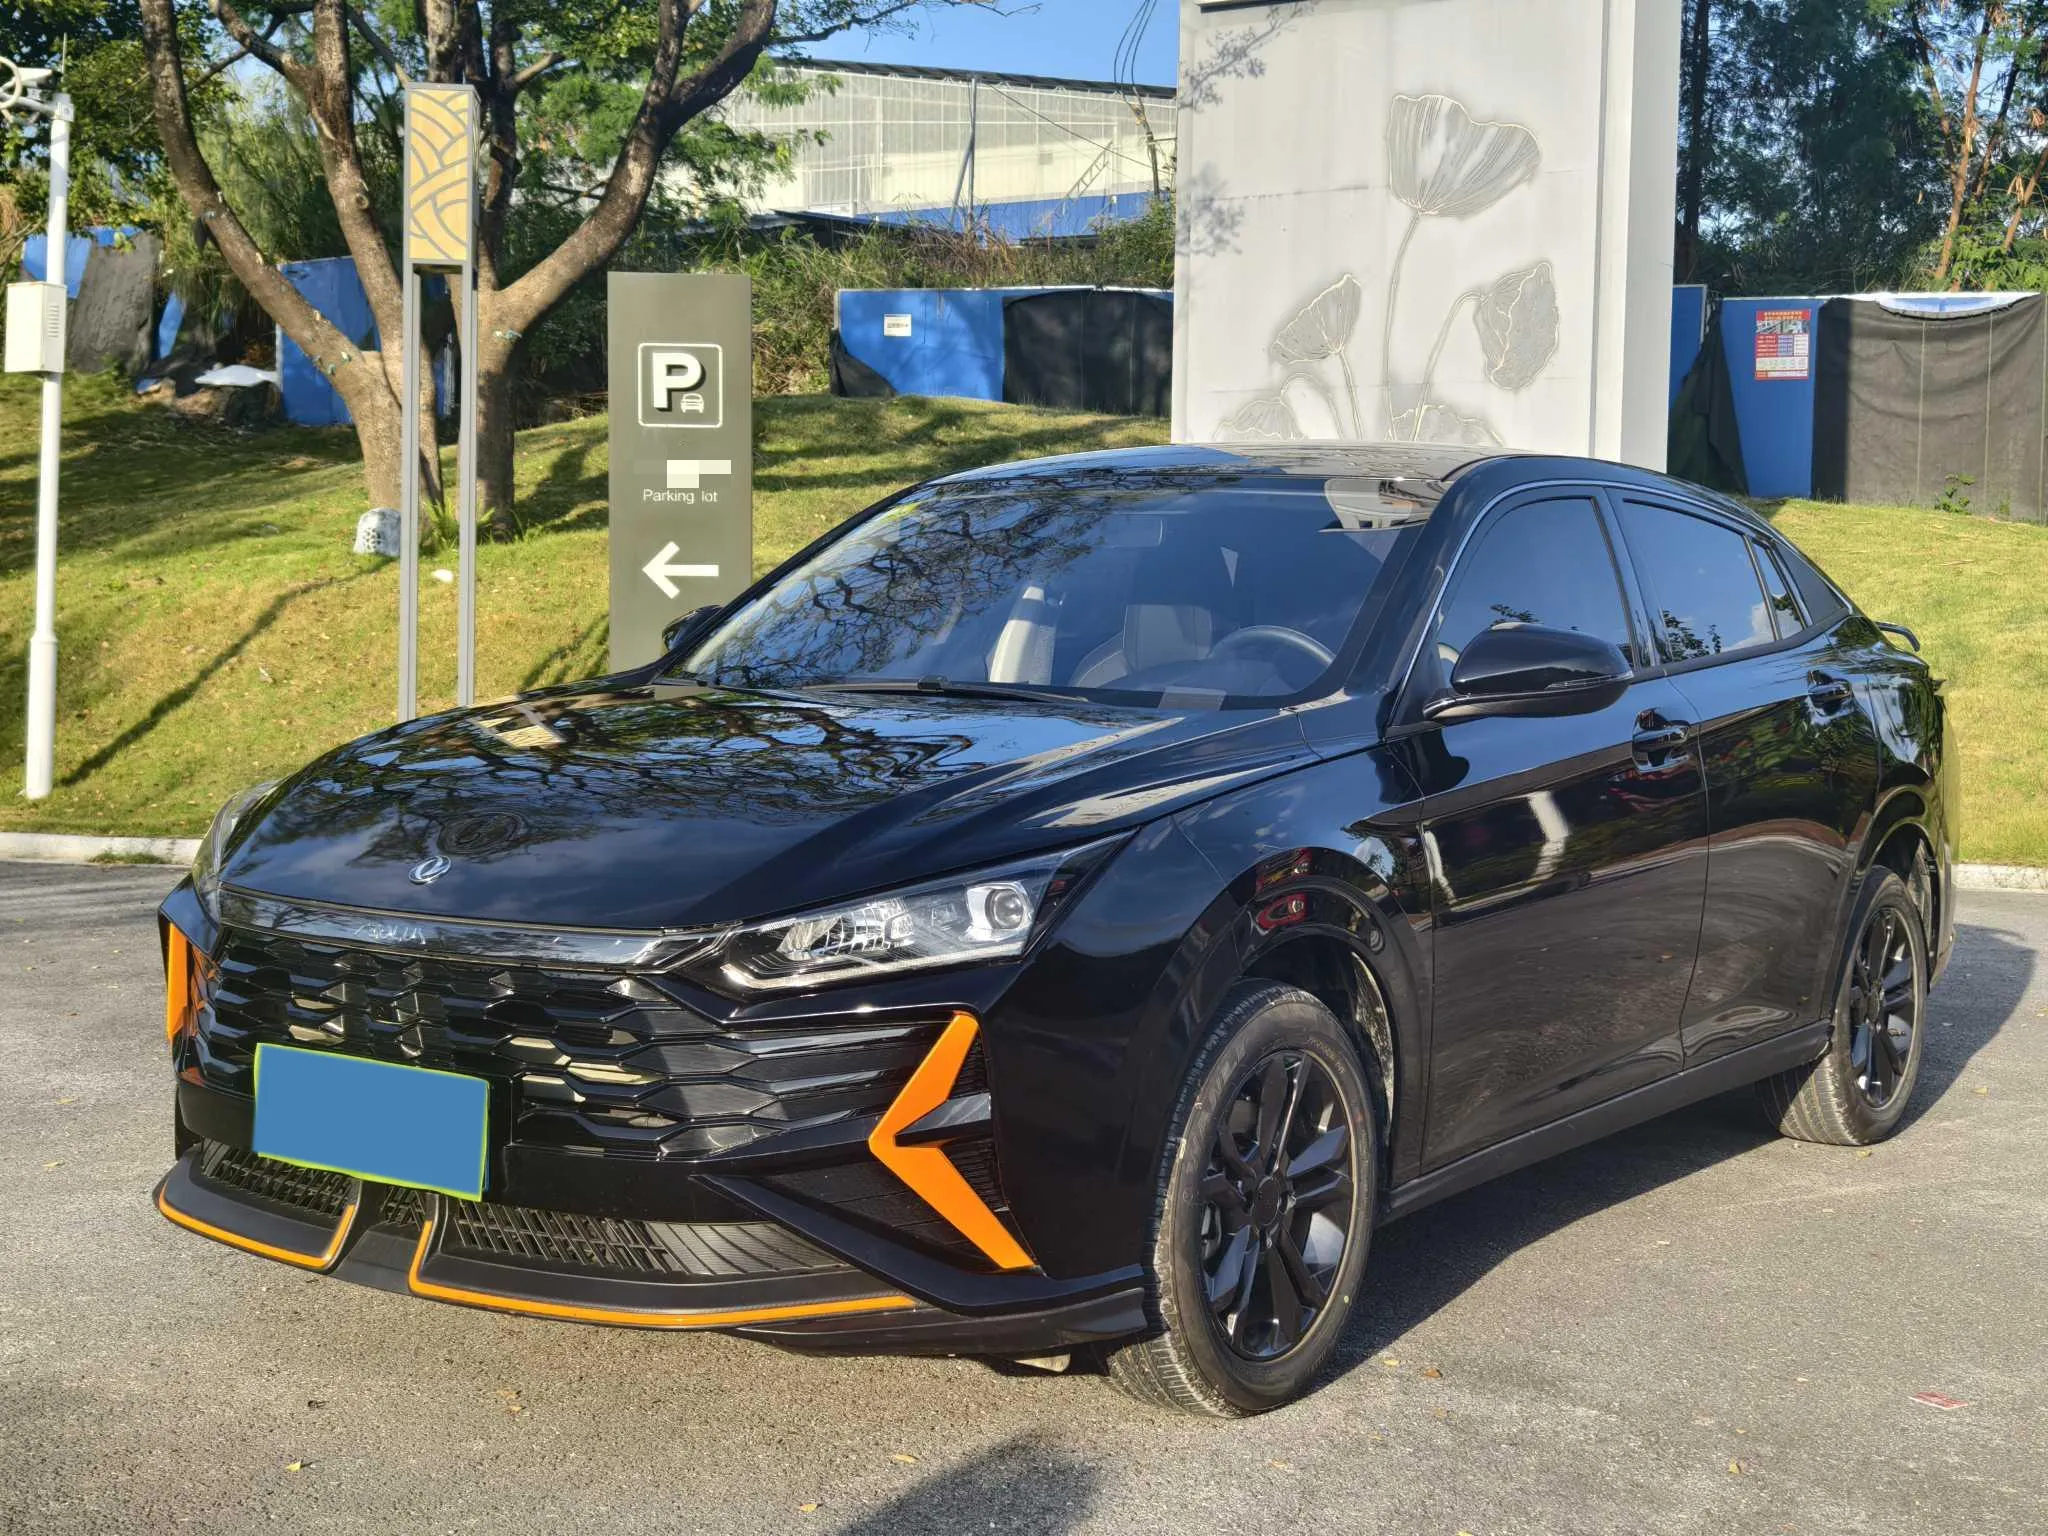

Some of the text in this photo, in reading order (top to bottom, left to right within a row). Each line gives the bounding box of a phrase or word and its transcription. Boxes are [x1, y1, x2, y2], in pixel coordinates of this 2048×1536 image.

[652, 352, 703, 409] P
[643, 489, 718, 504] Parking lot
